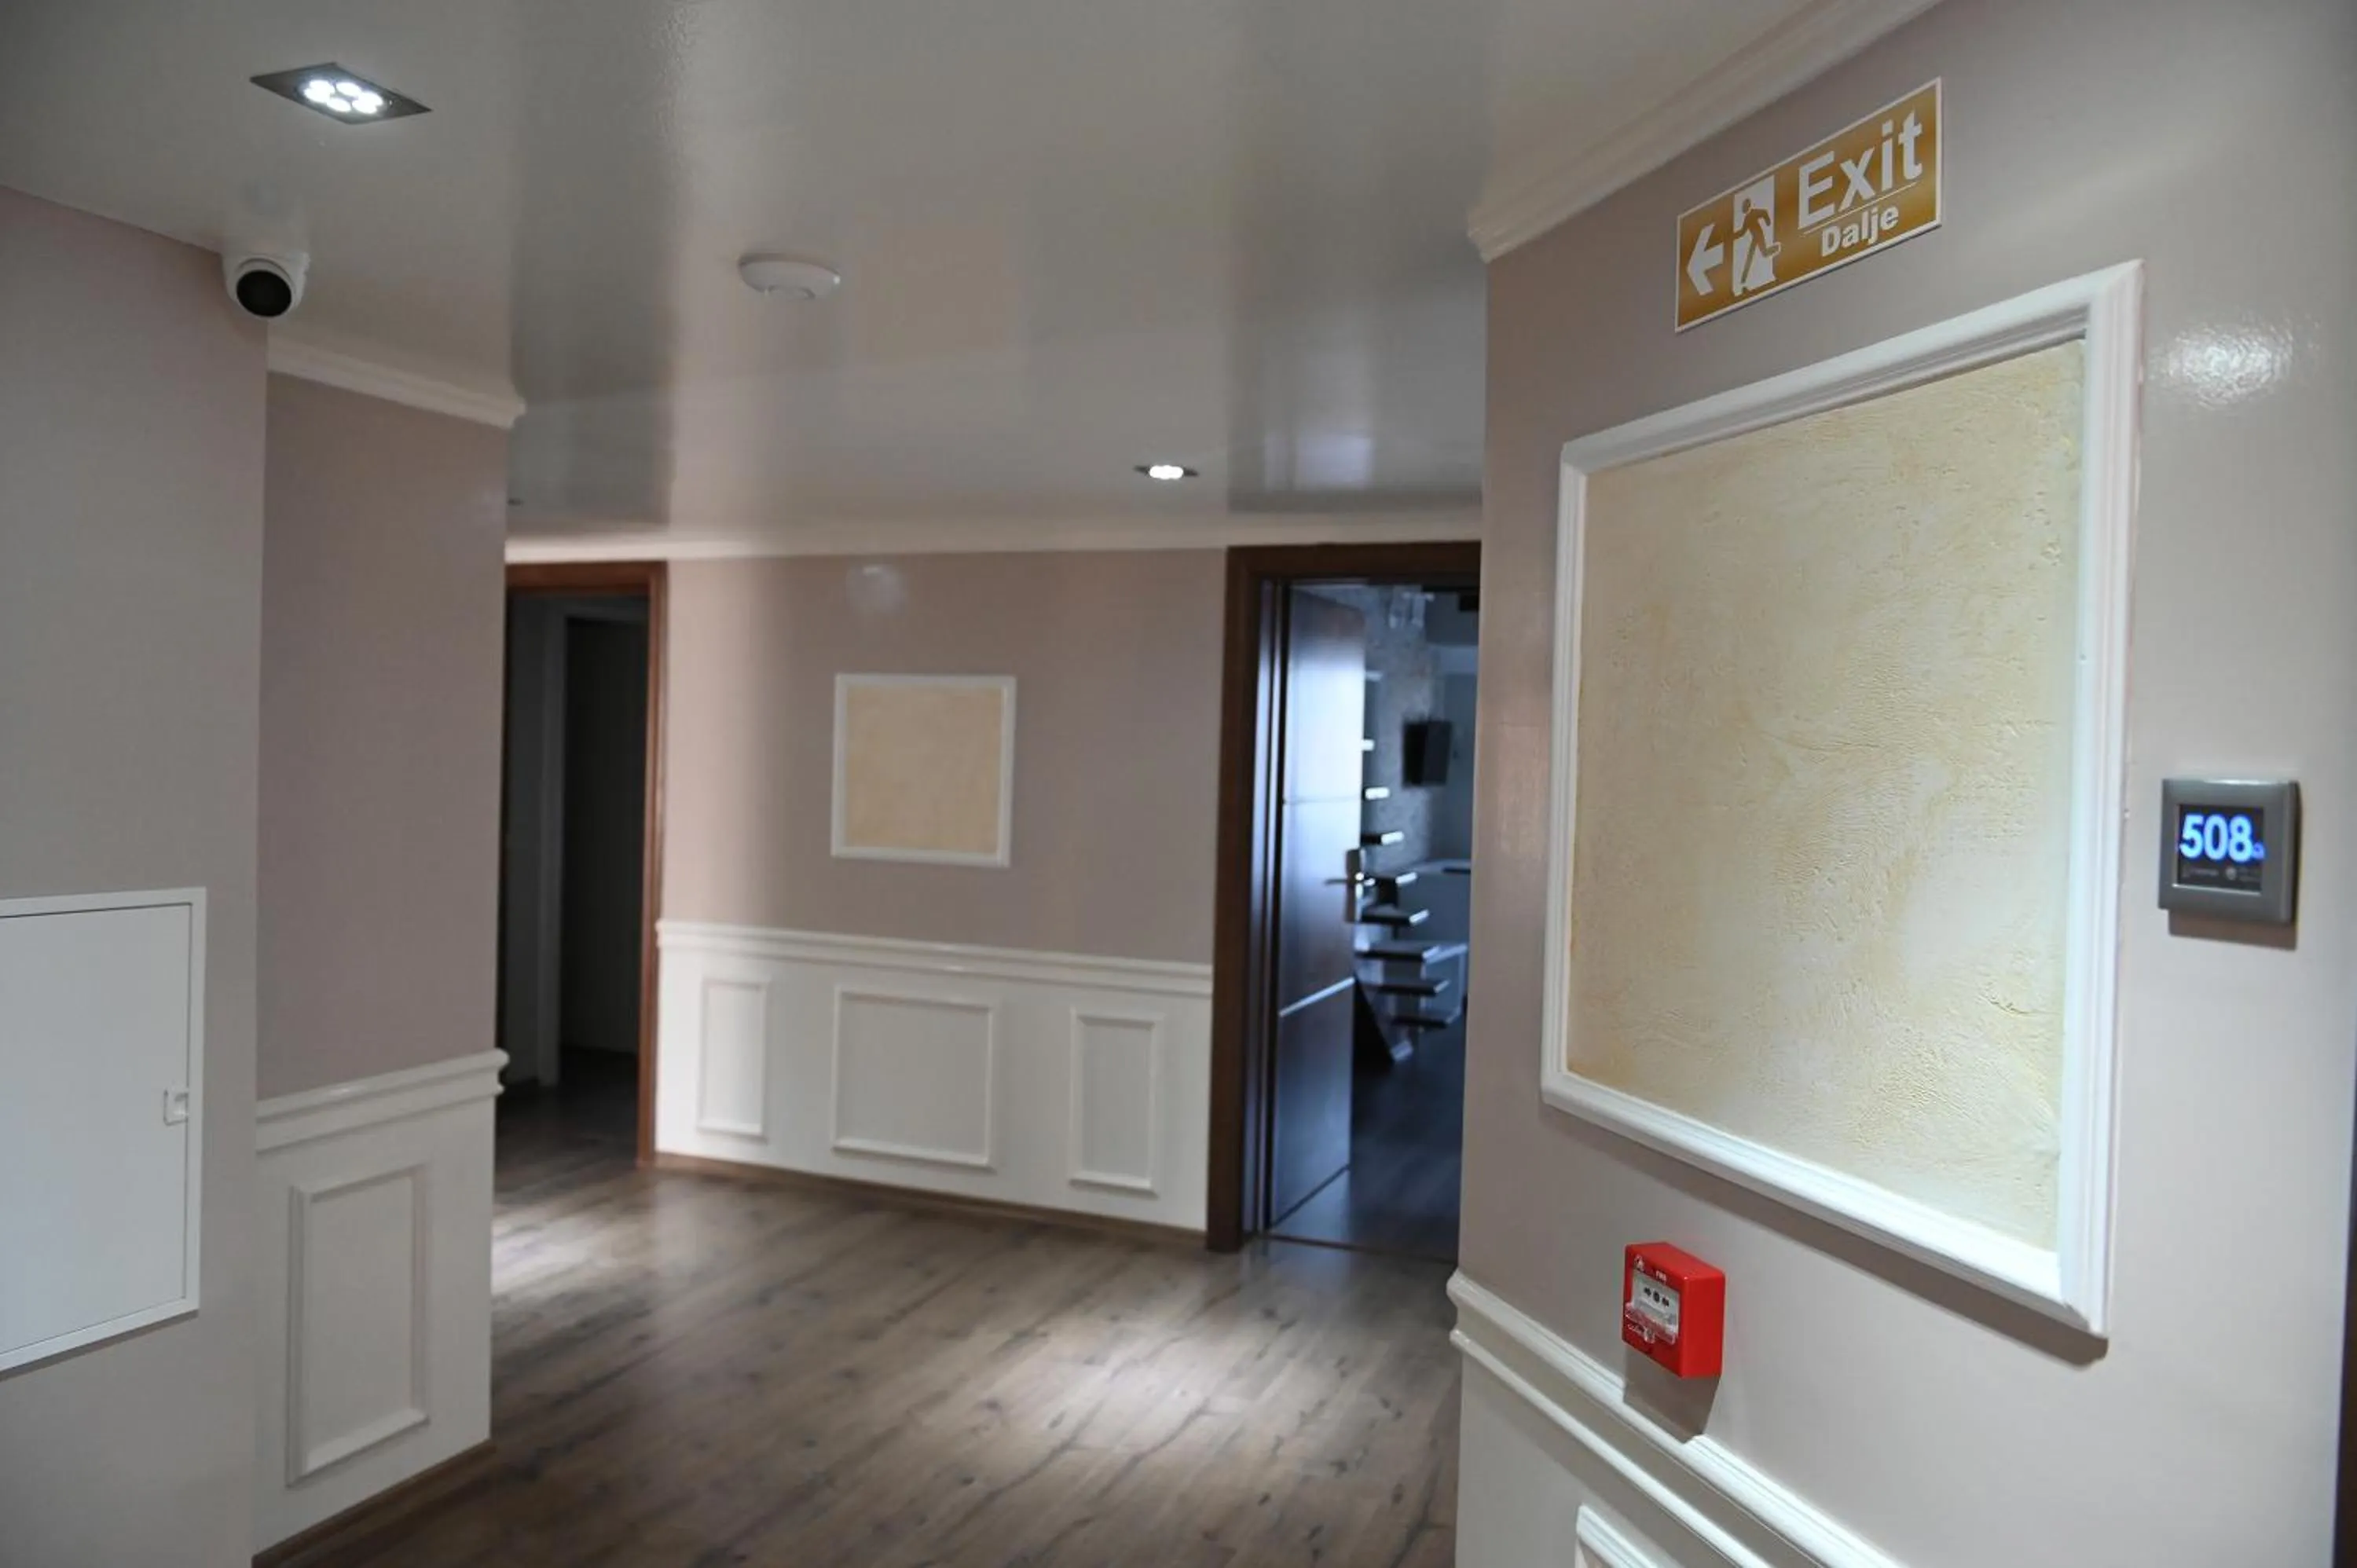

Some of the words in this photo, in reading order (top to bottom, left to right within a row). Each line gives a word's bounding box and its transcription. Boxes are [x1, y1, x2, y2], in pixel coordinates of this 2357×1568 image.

[1798, 111, 1923, 229] Exit
[1821, 205, 1899, 257] Dalje
[2179, 814, 2253, 863] 508
